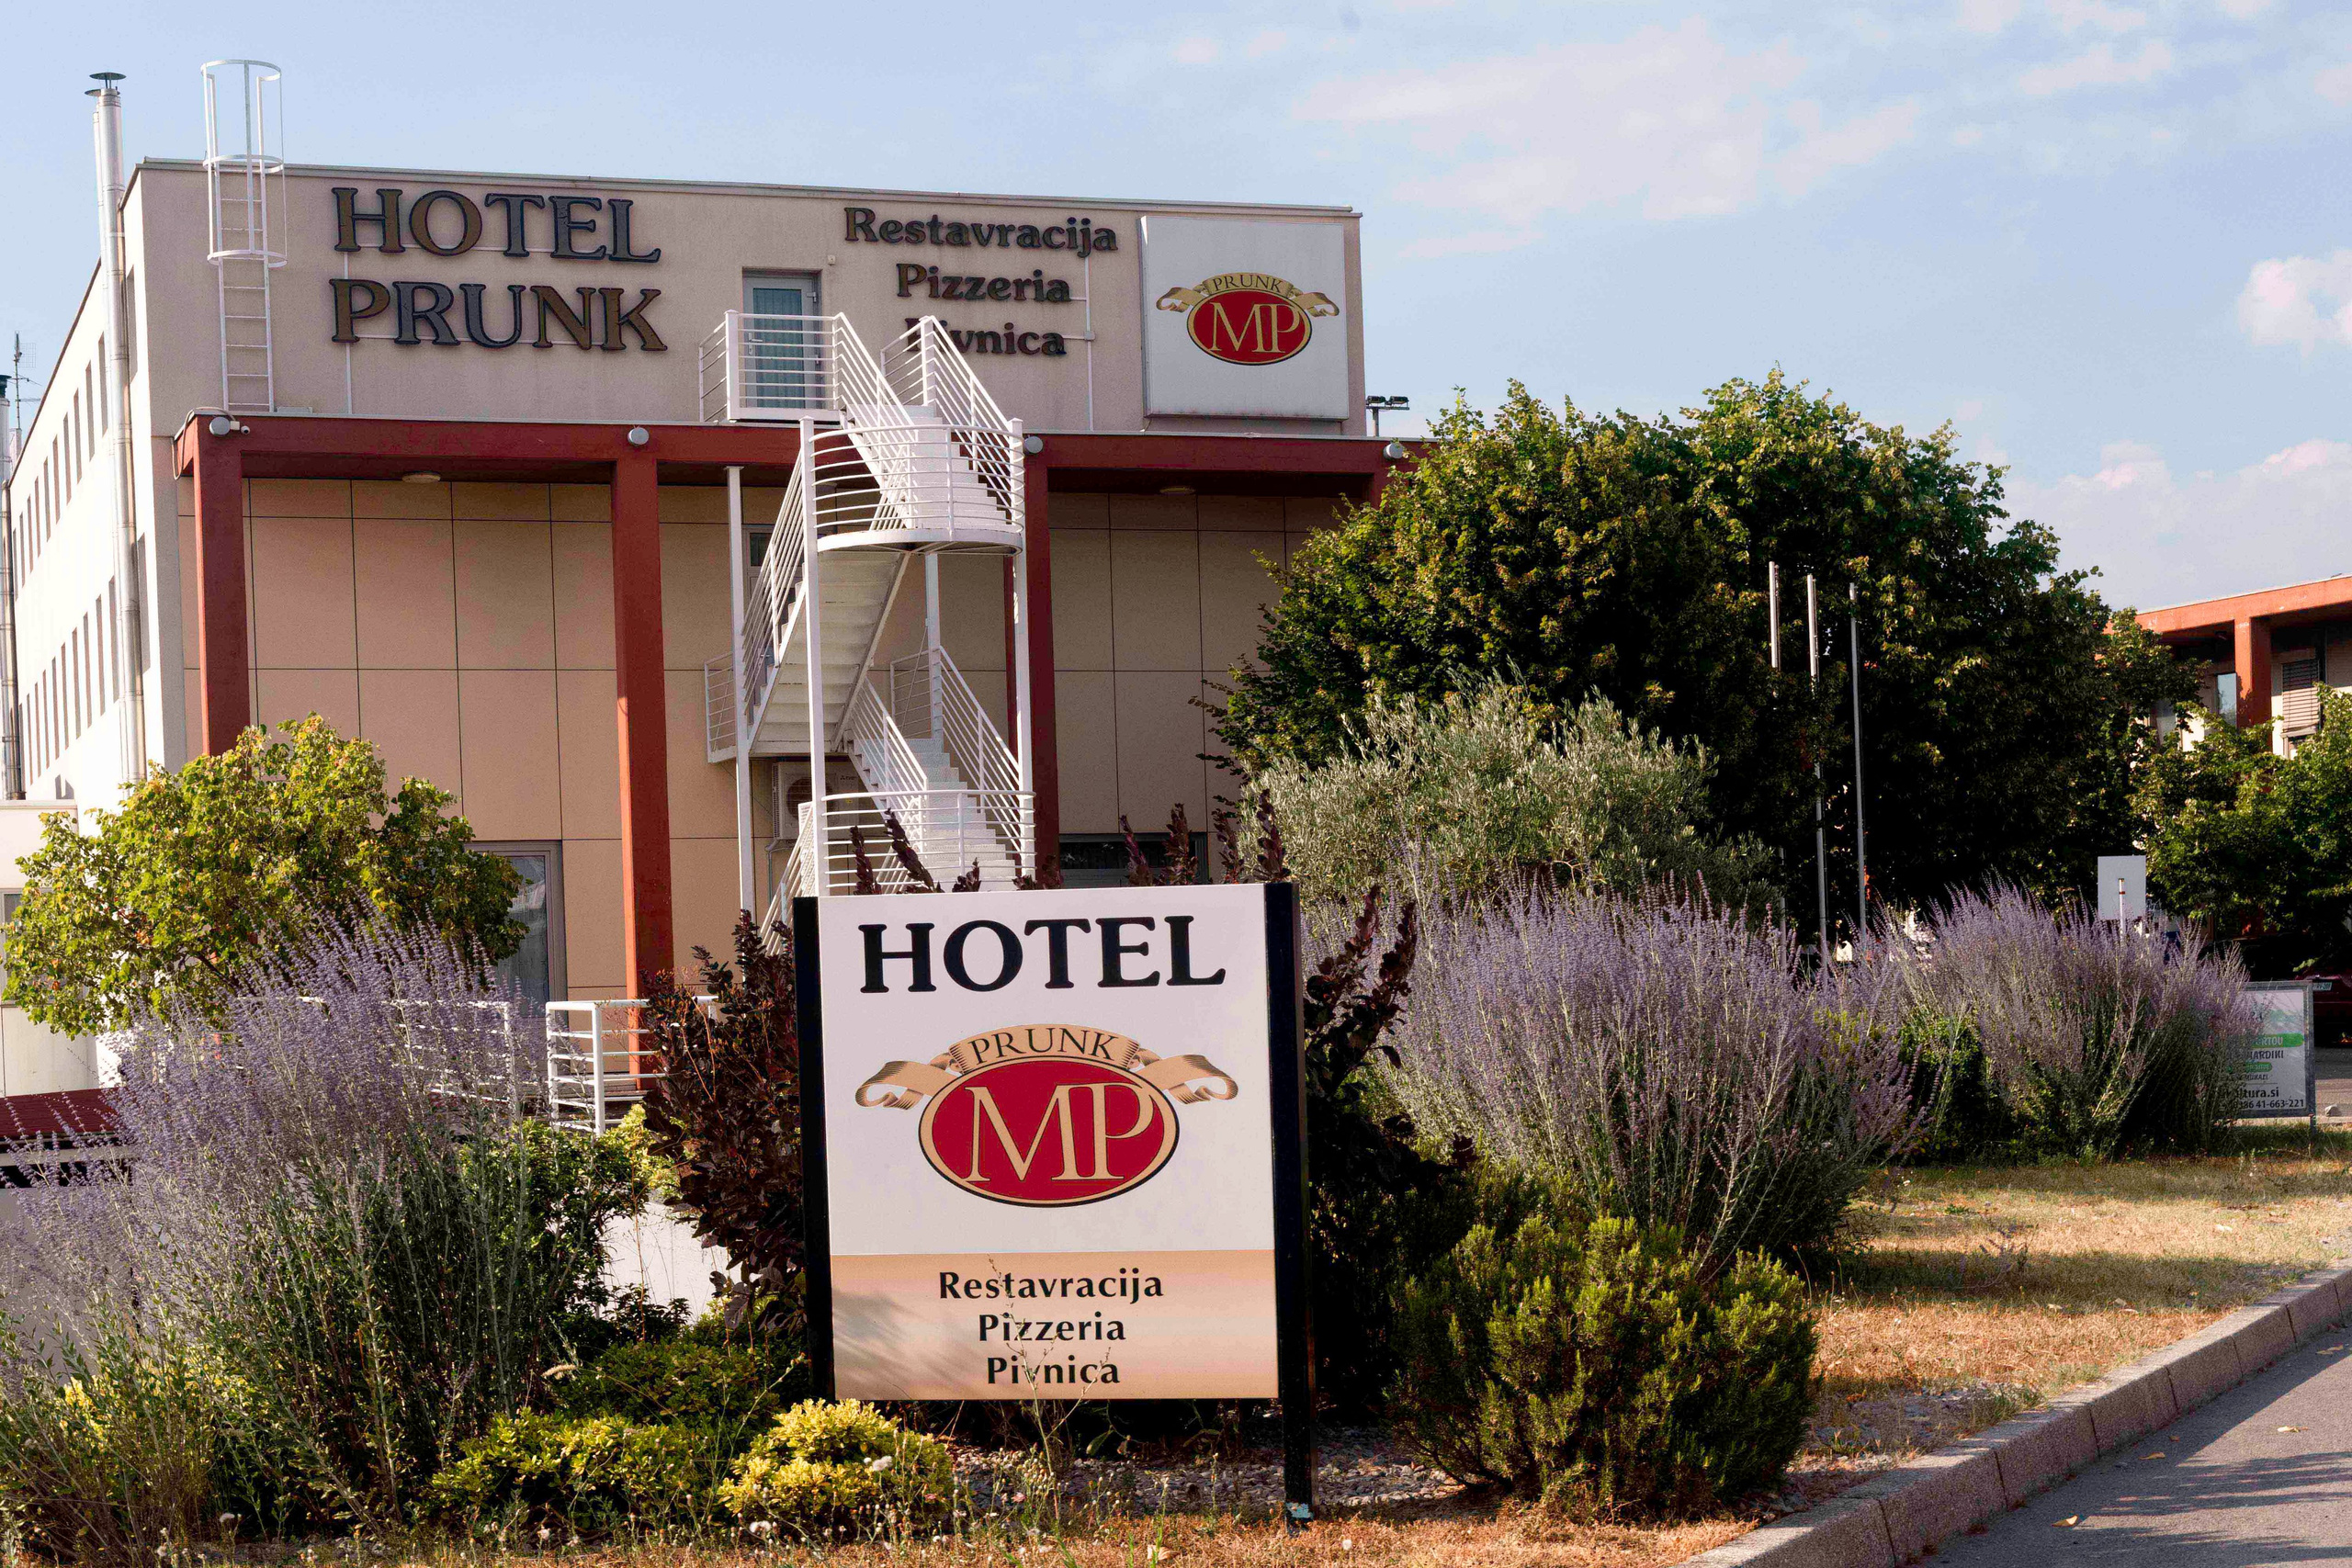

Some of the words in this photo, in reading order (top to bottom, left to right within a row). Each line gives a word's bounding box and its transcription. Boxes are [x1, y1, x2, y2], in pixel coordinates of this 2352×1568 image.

[331, 186, 662, 263] HOTEL
[843, 207, 1119, 258] Restavracija
[897, 263, 1071, 303] Pizzeria
[1212, 274, 1283, 293] PRUNK
[328, 278, 668, 351] PRUNK
[1208, 301, 1300, 353] MP
[858, 915, 1227, 994] HOTEL
[967, 1027, 1117, 1065] PRUNK
[2256, 1099, 2304, 1108] 41-663-221
[962, 1082, 1156, 1182] MP
[939, 1268, 1163, 1304] Restavracija
[979, 1311, 1126, 1341] Pizzeria
[987, 1355, 1120, 1384] Pivnica
